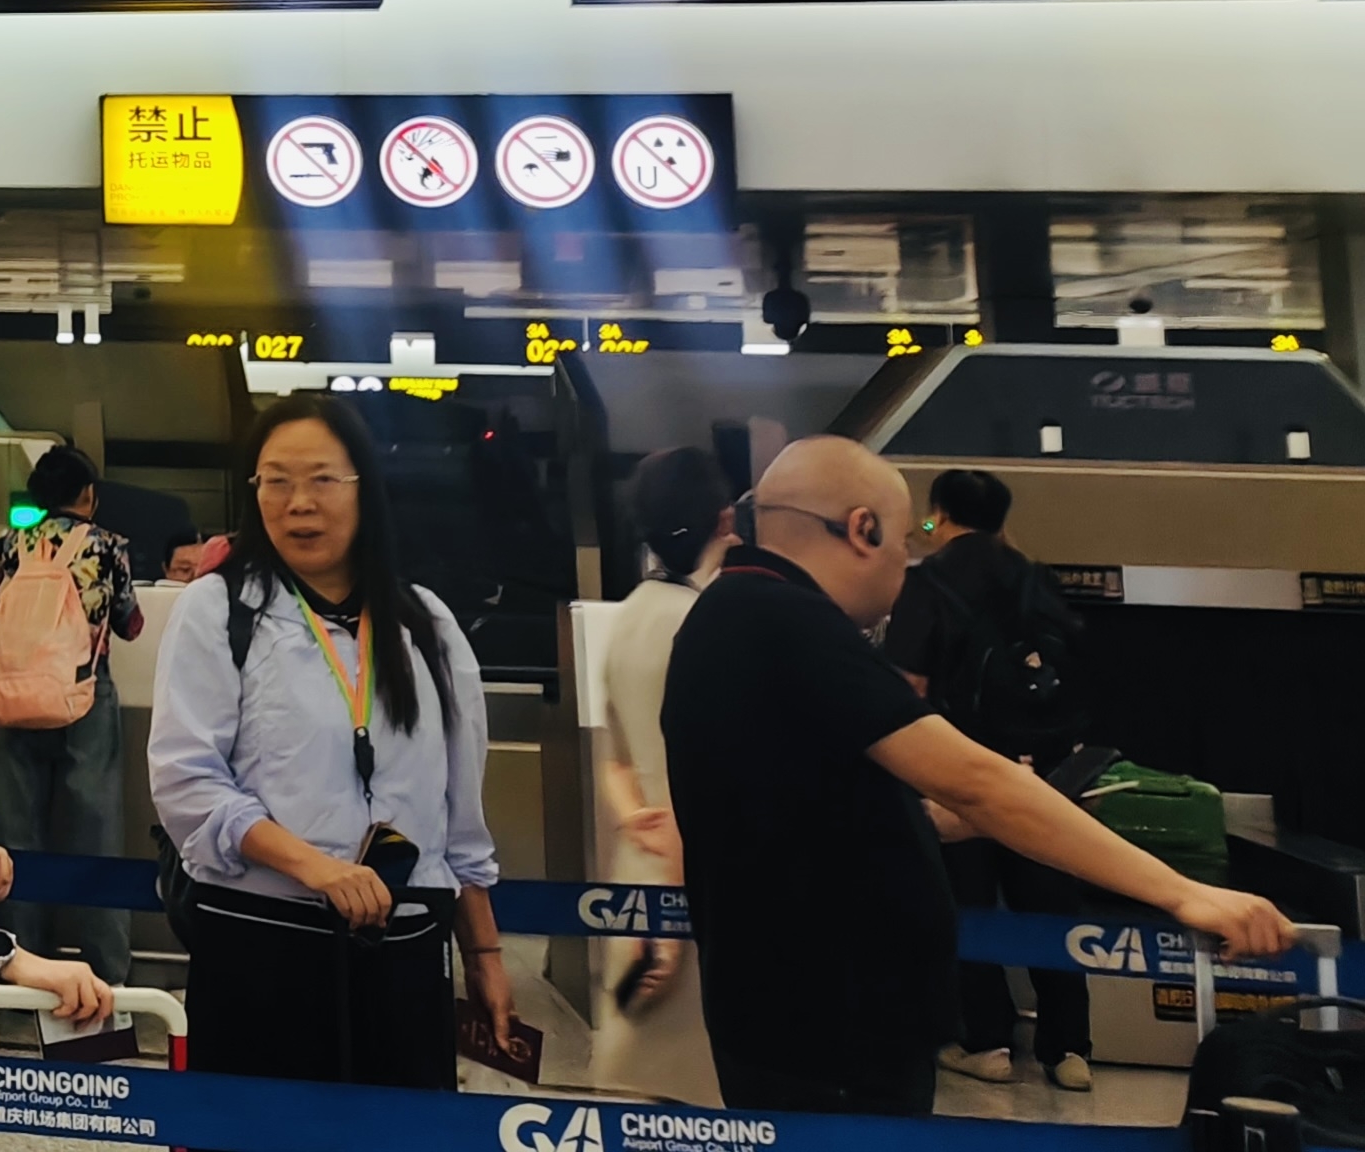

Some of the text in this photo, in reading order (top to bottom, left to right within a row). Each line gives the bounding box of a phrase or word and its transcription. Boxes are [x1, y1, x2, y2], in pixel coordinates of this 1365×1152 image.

[129, 104, 212, 143] 禁止
[128, 149, 212, 170] 托运物品
[526, 323, 549, 339] 3A
[598, 323, 622, 340] 3A
[887, 328, 913, 345] 3A
[255, 335, 303, 359] 027
[29, 1092, 63, 1107] Group
[66, 1095, 88, 1109] Co.,
[91, 1097, 112, 1110] Ltd.
[621, 1112, 776, 1145] CHONGQING
